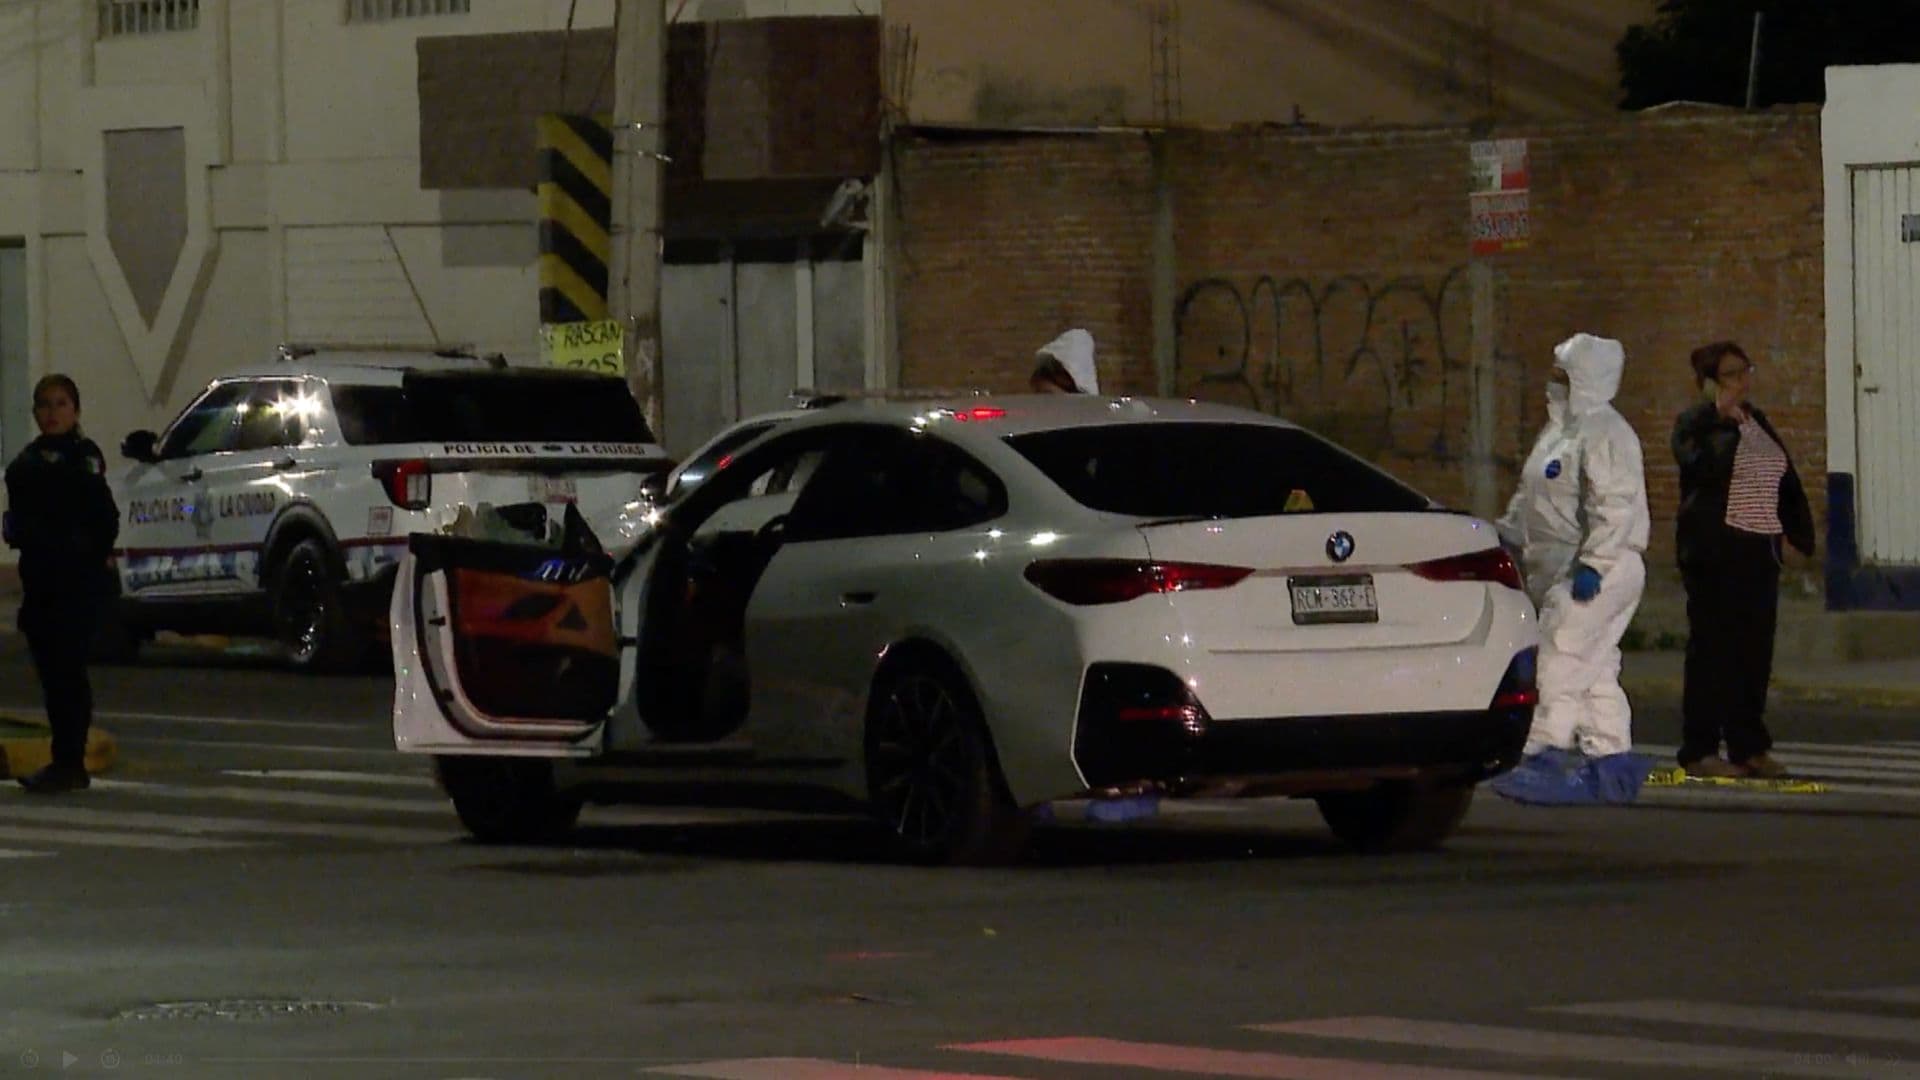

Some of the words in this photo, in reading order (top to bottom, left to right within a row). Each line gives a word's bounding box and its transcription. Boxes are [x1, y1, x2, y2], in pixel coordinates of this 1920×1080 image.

[443, 444, 510, 456] POLICIA
[514, 445, 537, 455] DE
[570, 444, 590, 455] LA
